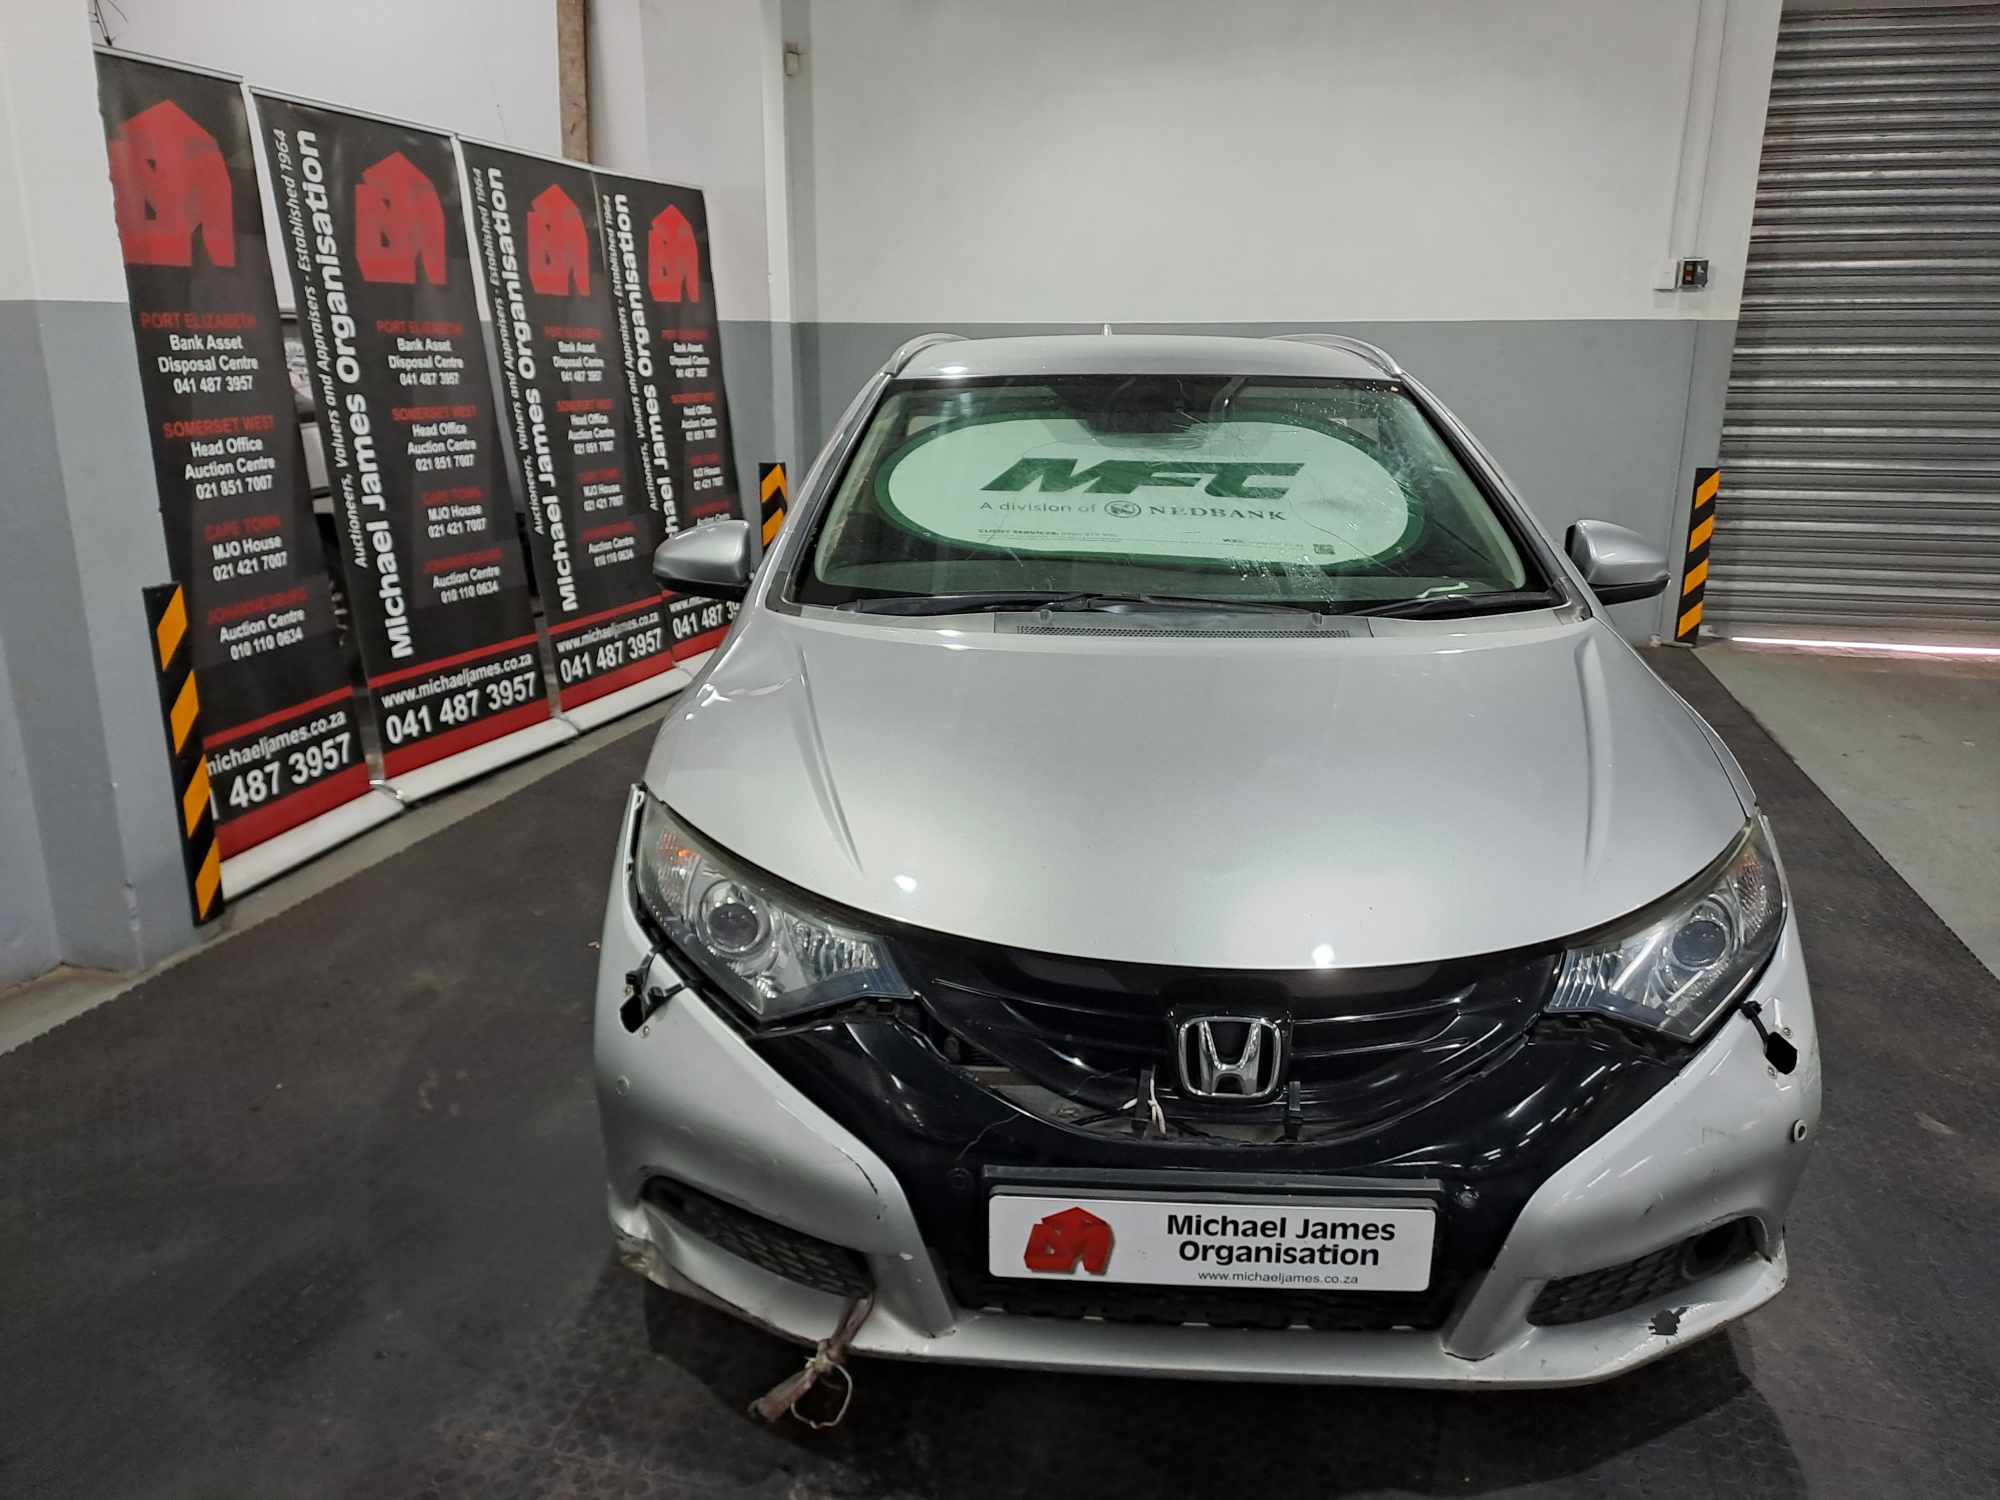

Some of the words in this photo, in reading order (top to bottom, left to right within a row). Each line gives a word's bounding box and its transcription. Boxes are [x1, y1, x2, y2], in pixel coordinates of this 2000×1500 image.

[273, 128, 293, 171] 1964
[281, 173, 311, 271] Established
[297, 130, 360, 384] Organisation
[488, 167, 536, 380] Organisation
[614, 194, 653, 377] Organisation
[169, 334, 204, 351] Bank
[206, 334, 244, 350] Asset
[305, 284, 331, 372] Appraisers
[158, 356, 217, 375] Disposal
[219, 355, 259, 371] Centre
[388, 355, 433, 371] Disposal
[173, 377, 196, 394] 041
[200, 376, 221, 393] 487
[225, 375, 254, 392] 3957
[318, 373, 337, 406] and
[328, 409, 348, 468] Valuers
[412, 424, 438, 437] Head
[525, 388, 556, 488] James
[643, 384, 669, 471] James
[191, 440, 225, 458] Head
[226, 436, 263, 454] Office
[345, 393, 386, 511] James
[407, 441, 445, 455] Auction
[185, 461, 235, 480] Auction
[236, 456, 275, 474] Centre
[195, 482, 218, 500] 021
[220, 478, 243, 496] 851
[245, 474, 273, 492] 7007
[341, 474, 368, 569] Auctioneers,
[450, 504, 482, 518] House
[657, 476, 680, 538] hael
[979, 502, 993, 512] A
[999, 502, 1072, 513] division
[1078, 503, 1097, 513] of
[1149, 505, 1287, 521] NEDBANK
[212, 541, 241, 561] MJO
[243, 535, 283, 554] House
[542, 495, 579, 612] Michael
[212, 563, 234, 582] 021
[237, 557, 259, 575] 421
[261, 551, 288, 571] 7007
[433, 571, 469, 589] Auction
[366, 520, 414, 659] Michael
[220, 618, 267, 643] Auction
[267, 608, 305, 629] Centre
[673, 612, 698, 639] 041
[701, 604, 723, 628] 487
[230, 641, 252, 661] 010
[253, 634, 275, 652] 110
[276, 626, 304, 647] 0634
[560, 653, 592, 684] 041
[596, 640, 624, 671] 487
[627, 627, 663, 660] 3957
[381, 653, 534, 709] www.michaeljames.co.za
[385, 704, 432, 745] 041
[439, 688, 480, 725] 487
[486, 671, 536, 711] 3957
[228, 760, 281, 808] 487
[288, 732, 351, 785] 3957
[1167, 1214, 1287, 1239] Michael
[1296, 1218, 1396, 1241] James
[1179, 1240, 1380, 1266] Organisation
[1197, 1271, 1359, 1285] www.michaeljames.co.za
